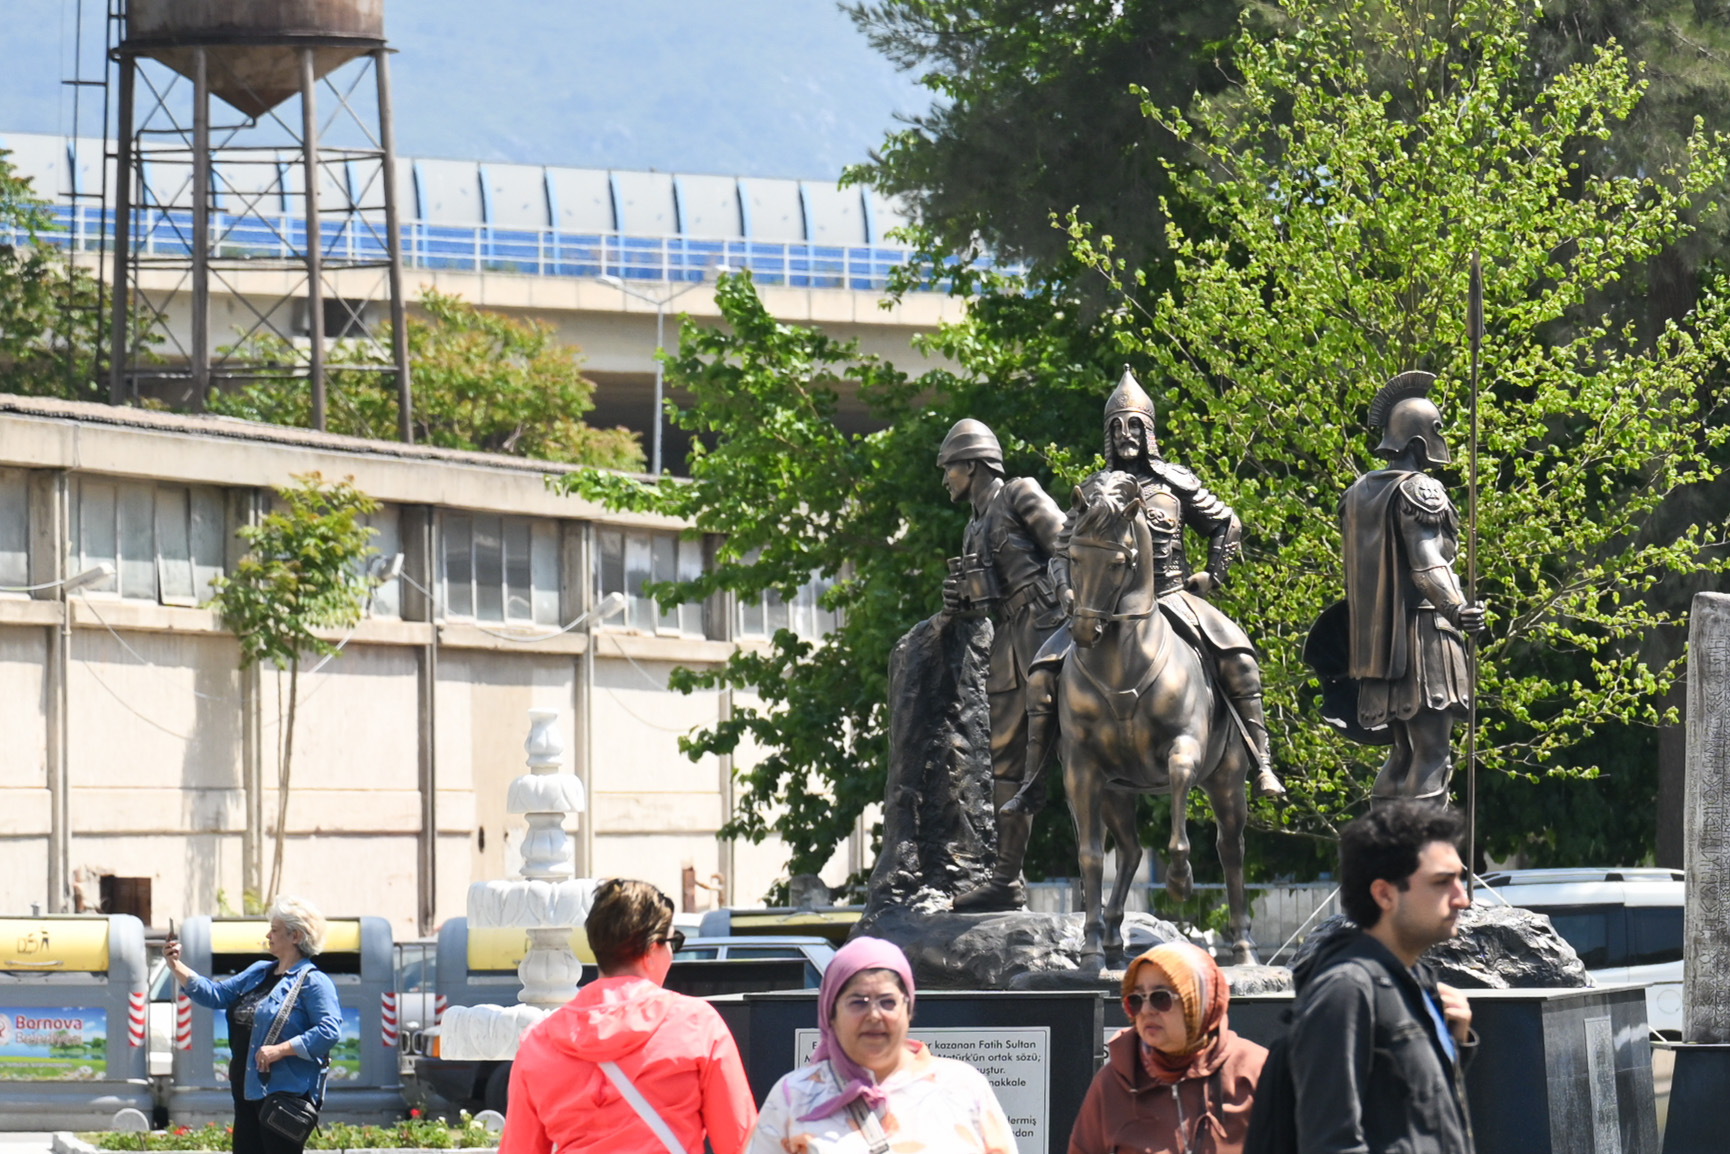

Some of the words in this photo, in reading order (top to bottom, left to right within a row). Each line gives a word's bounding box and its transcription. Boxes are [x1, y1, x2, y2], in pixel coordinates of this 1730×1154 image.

[15, 1015, 83, 1030] Bornova
[934, 1040, 976, 1050] kazanan
[978, 1039, 1003, 1050] Fatih
[1005, 1039, 1037, 1050] Sultan
[987, 1052, 1014, 1062] ortak
[1015, 1053, 1042, 1064] sözü;
